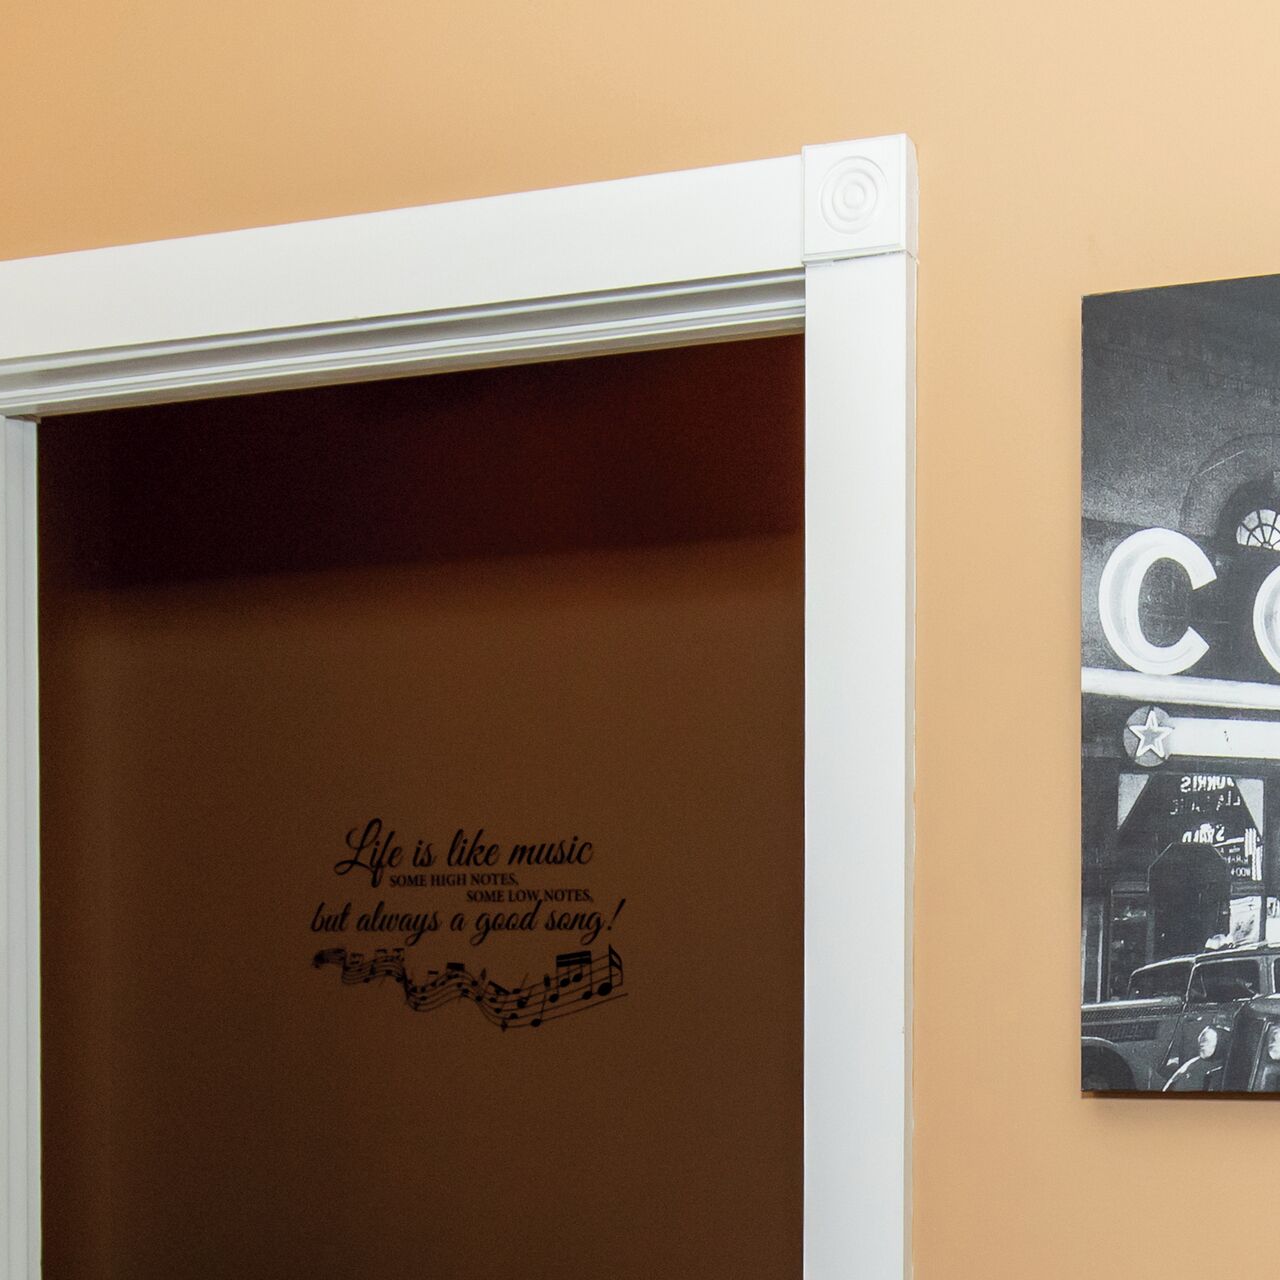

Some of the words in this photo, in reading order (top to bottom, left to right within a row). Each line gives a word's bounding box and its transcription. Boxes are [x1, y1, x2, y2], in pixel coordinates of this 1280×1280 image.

[334, 818, 404, 888] Life
[412, 838, 437, 868] is
[447, 828, 499, 867] like
[507, 835, 594, 866] music
[389, 874, 427, 887] SOME
[430, 874, 467, 887] HIGH
[470, 873, 519, 886] NOTES,
[466, 889, 505, 902] SOME
[508, 889, 540, 902] LOW
[310, 902, 352, 932] but
[356, 901, 441, 946] always
[450, 913, 467, 932] a
[470, 899, 543, 946] good
